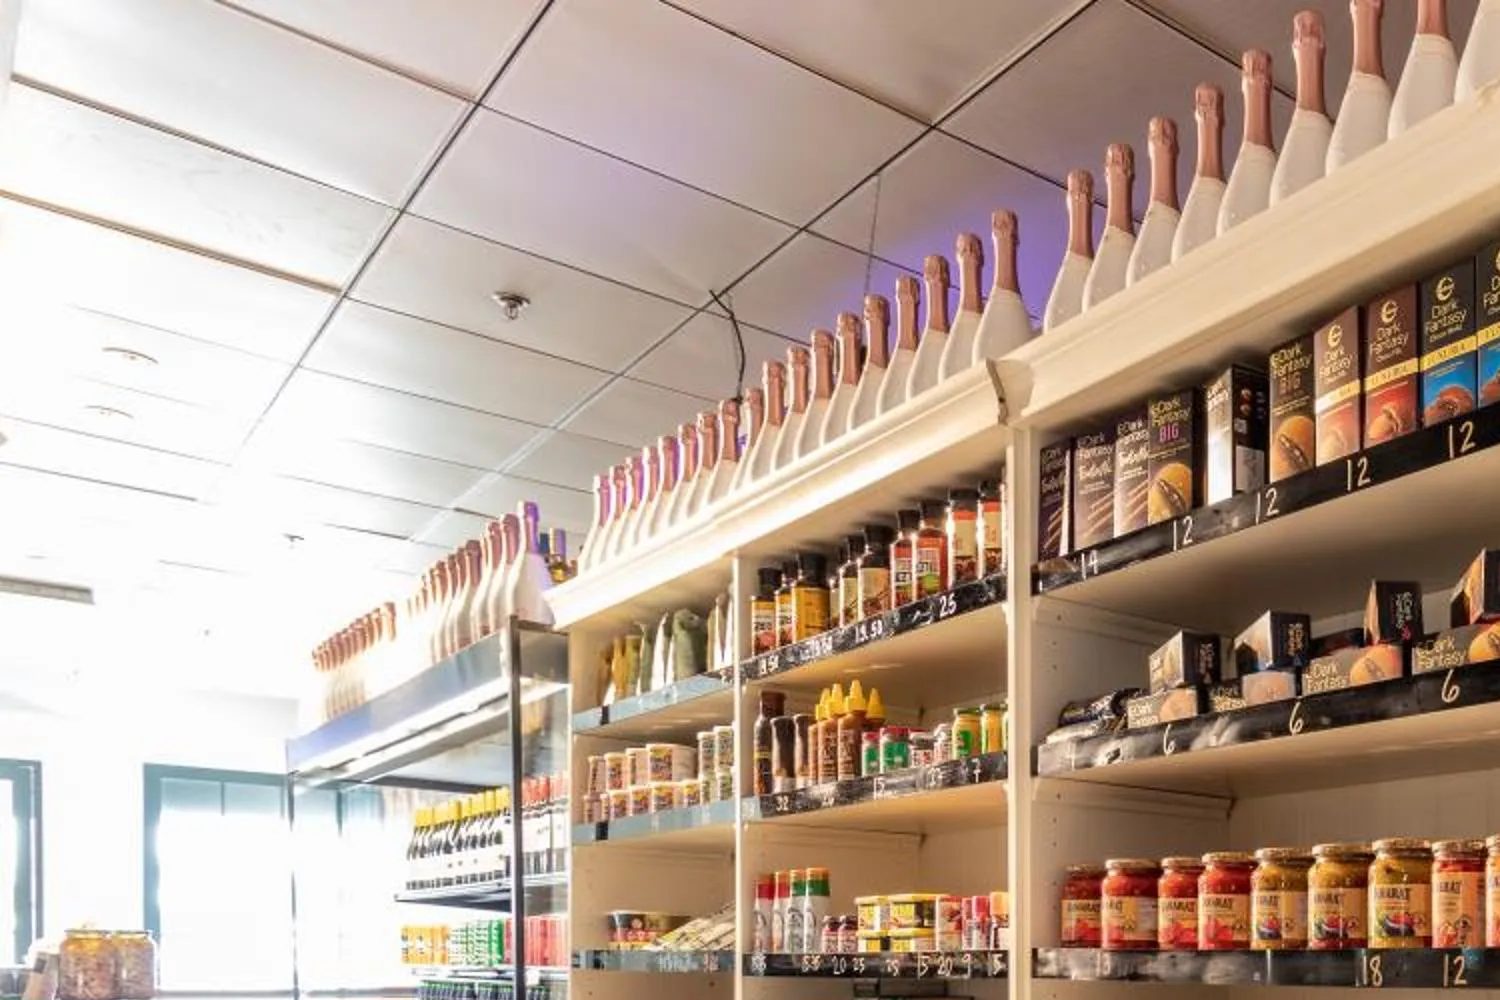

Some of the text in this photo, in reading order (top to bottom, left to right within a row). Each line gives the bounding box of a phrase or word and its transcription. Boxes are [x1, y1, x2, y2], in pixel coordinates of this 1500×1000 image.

[1424, 308, 1468, 336] Fantasy
[1431, 299, 1458, 320] Dark
[1370, 332, 1410, 357] Fantasy
[1376, 324, 1402, 342] Dark
[1159, 422, 1180, 443] BIG
[1447, 422, 1475, 459] 12
[1346, 457, 1372, 491] 12
[1255, 487, 1280, 525] 12
[1172, 514, 1195, 551] 12
[1441, 668, 1461, 704] 6
[1288, 701, 1305, 735] 6
[1162, 723, 1177, 757] 6
[1442, 952, 1468, 988] 12
